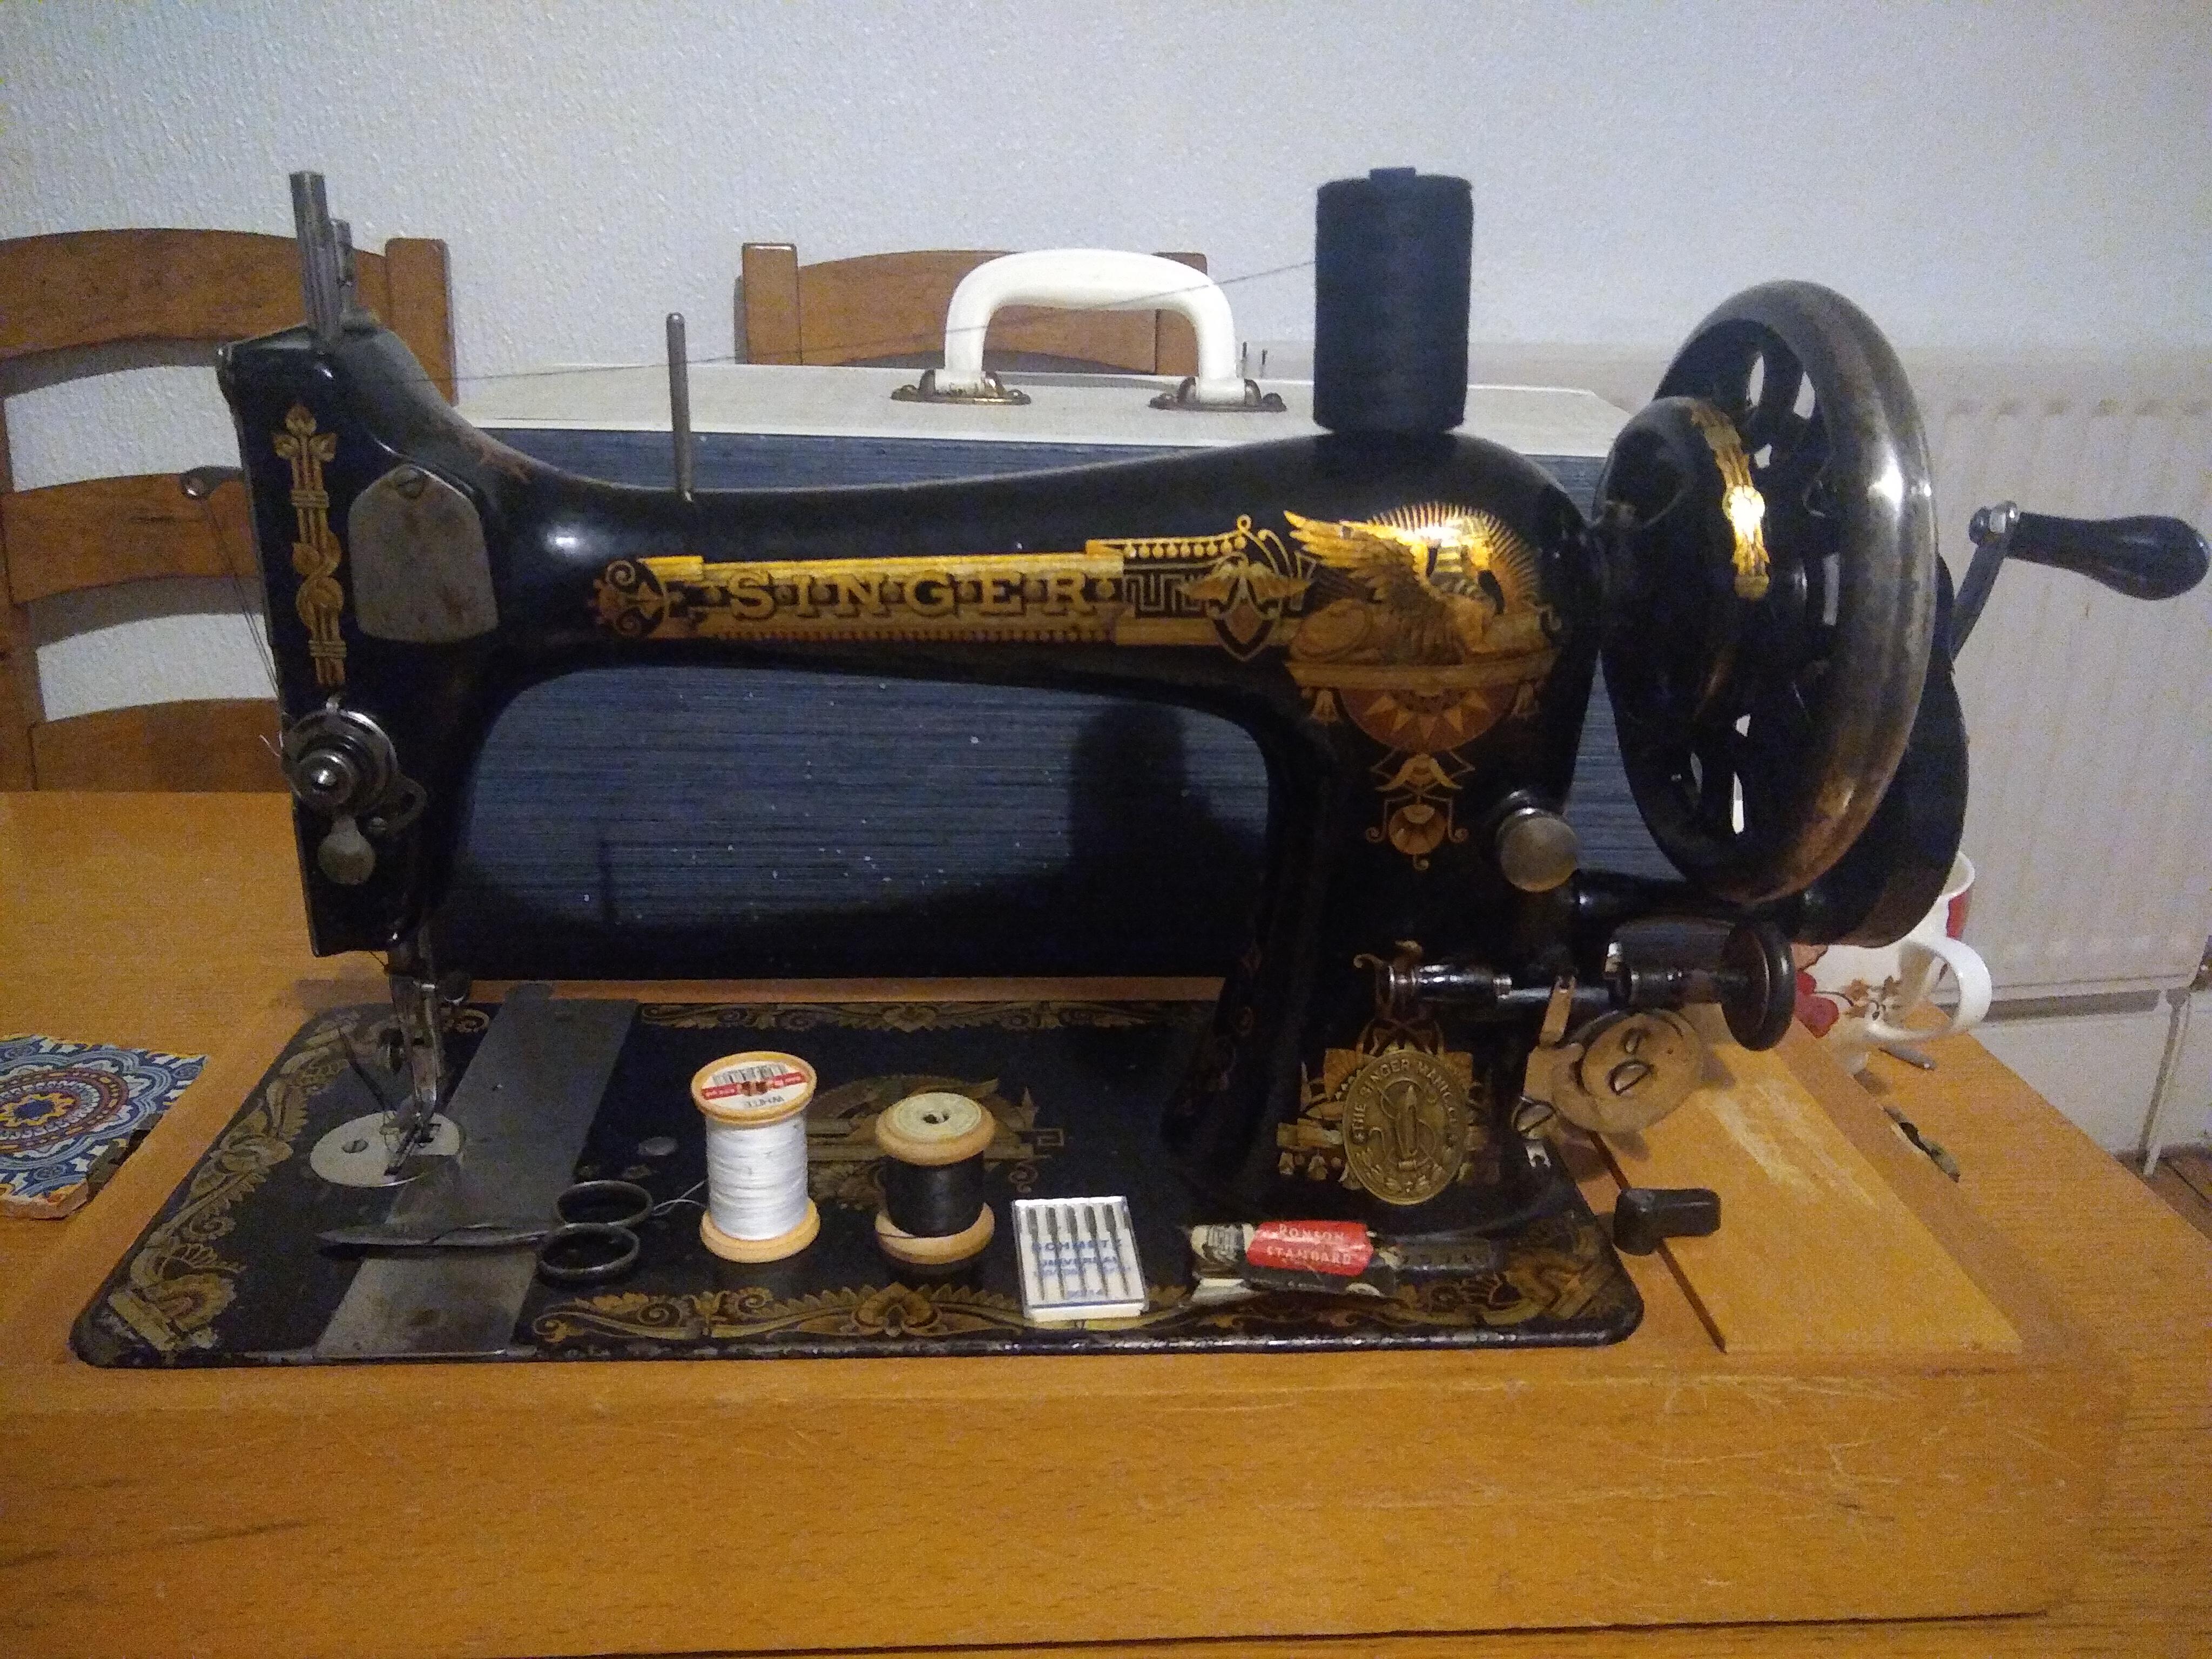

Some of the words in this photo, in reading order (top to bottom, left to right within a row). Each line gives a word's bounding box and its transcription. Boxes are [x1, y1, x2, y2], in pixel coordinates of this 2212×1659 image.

[729, 570, 1097, 621] SINGER
[1360, 1058, 1411, 1097] SINGER
[1278, 1223, 1344, 1244] RONSON
